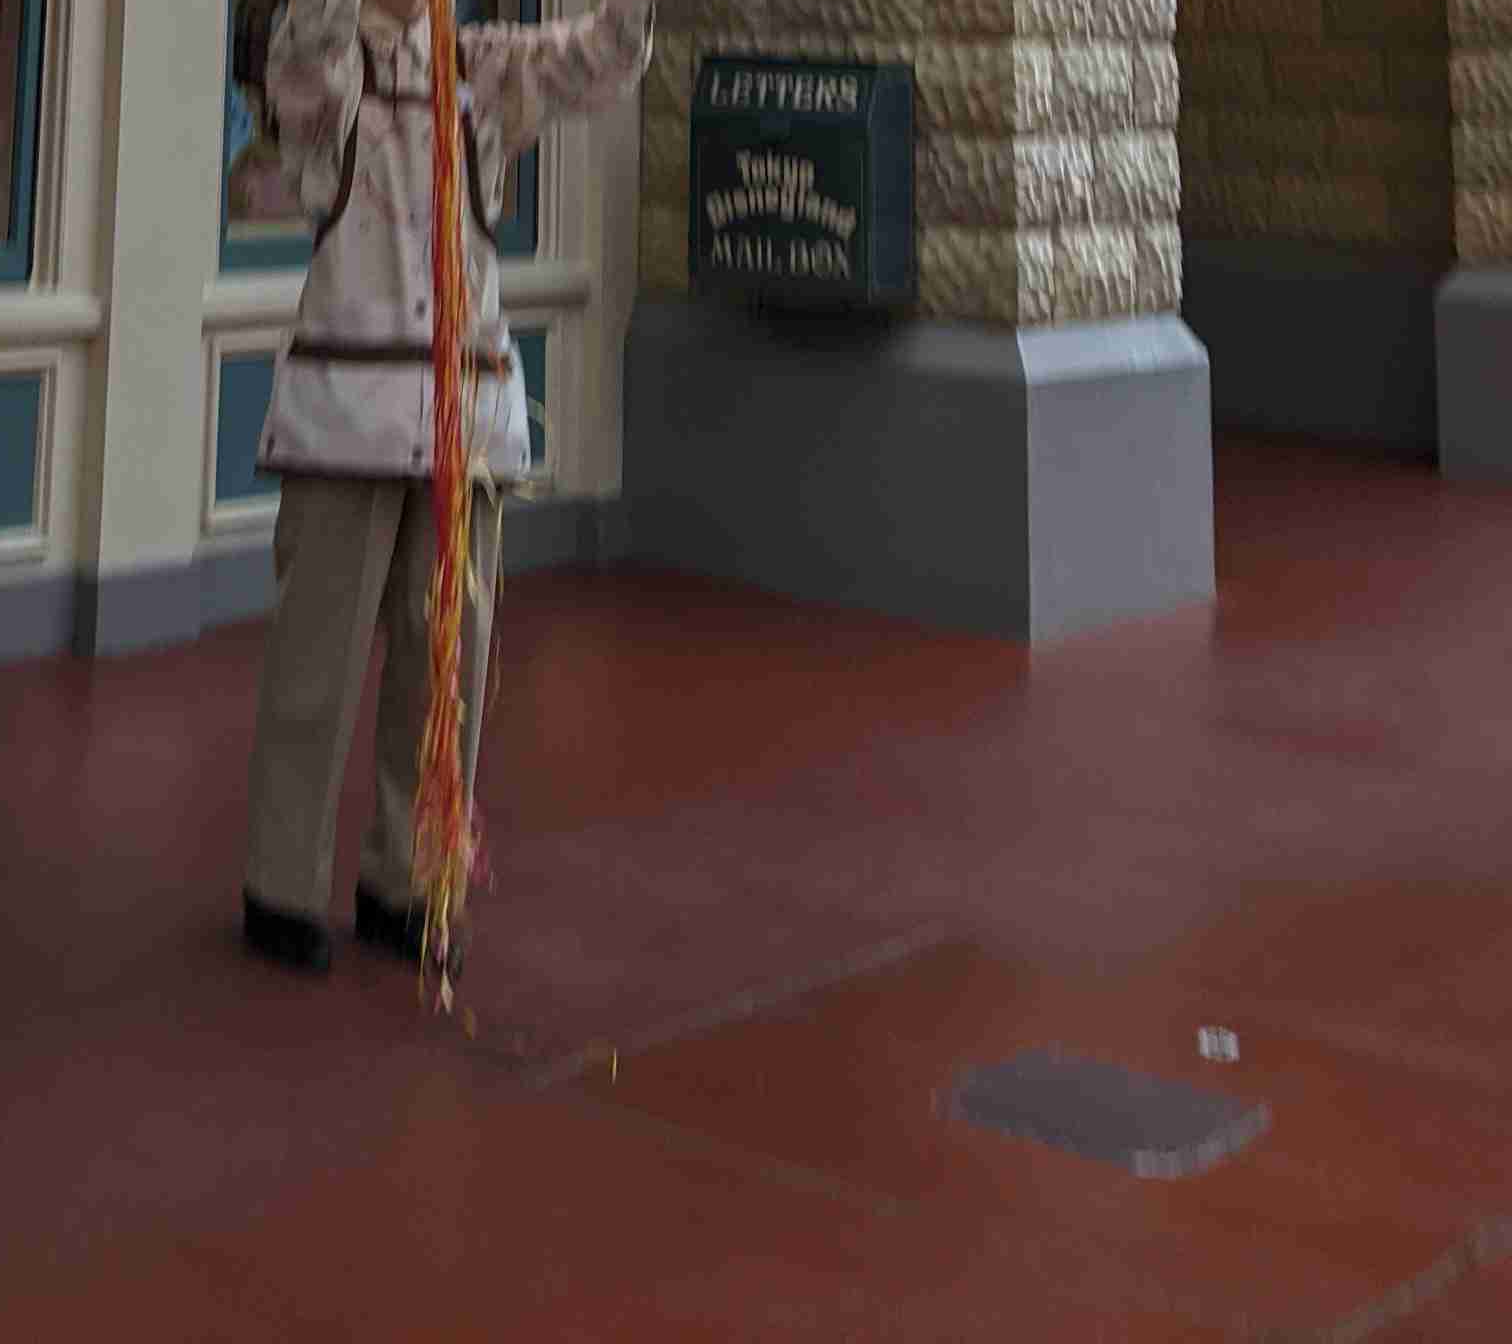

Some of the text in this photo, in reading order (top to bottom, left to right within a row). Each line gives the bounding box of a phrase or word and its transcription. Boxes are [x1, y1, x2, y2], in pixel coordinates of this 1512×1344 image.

[710, 70, 858, 112] LETTERS
[710, 232, 852, 281] MAIL BOX
